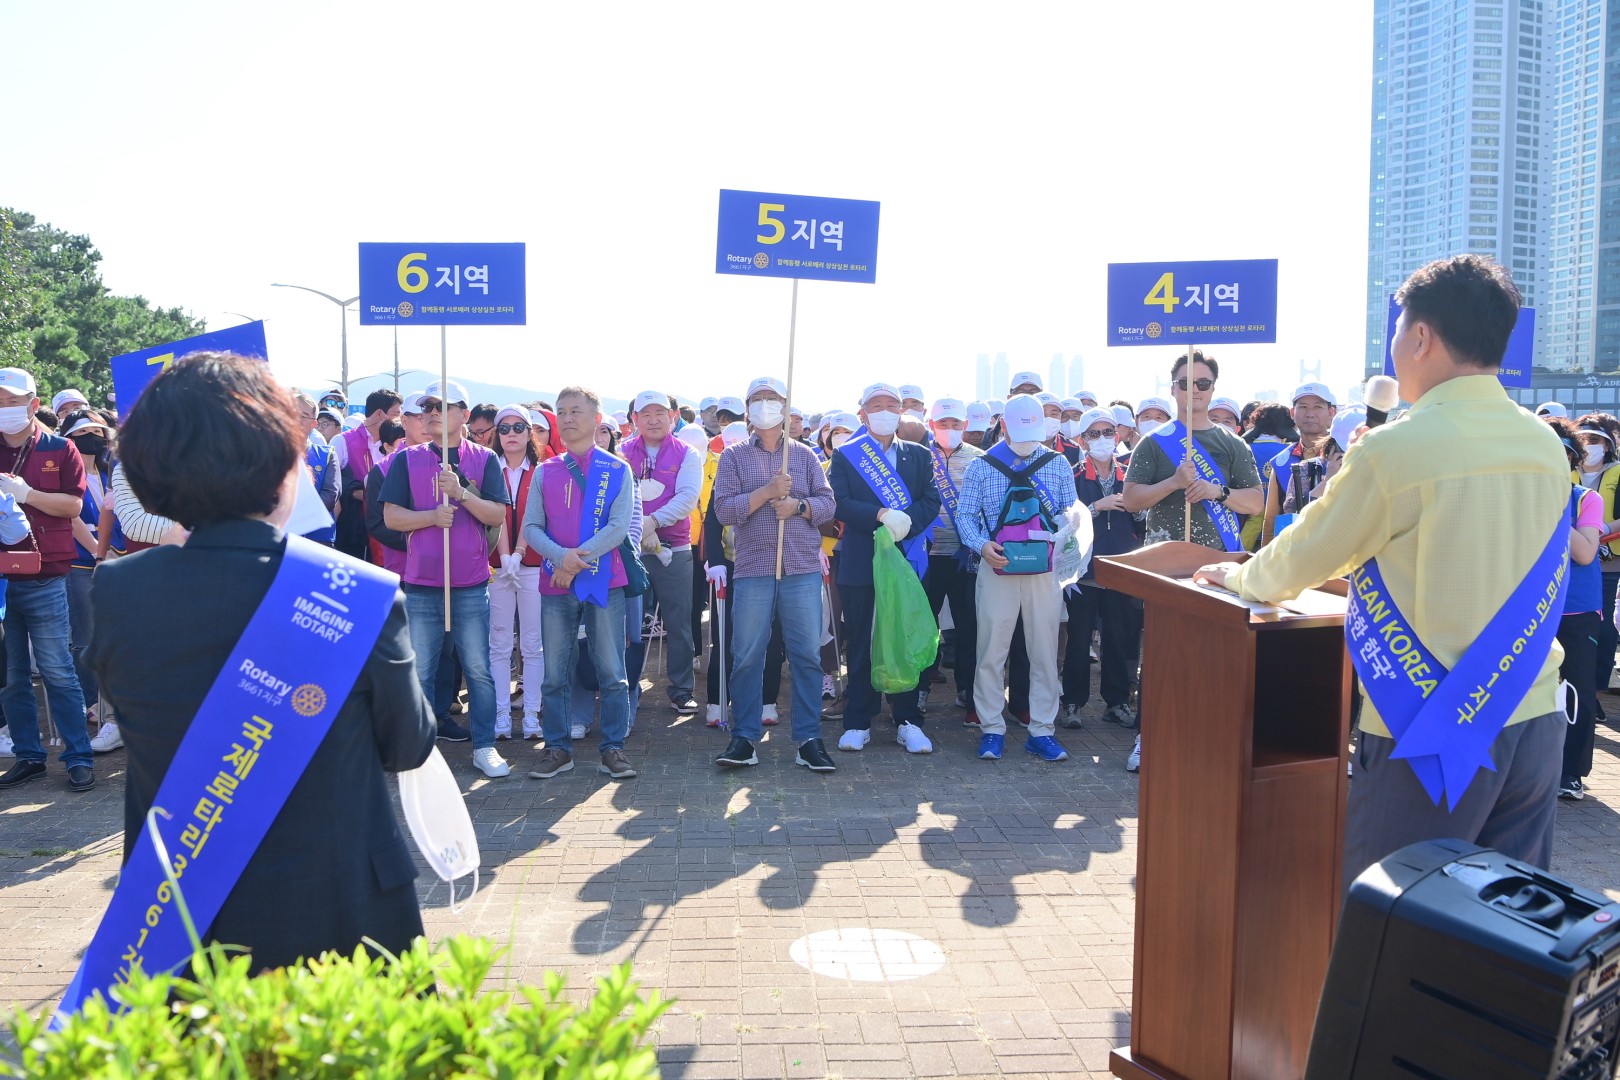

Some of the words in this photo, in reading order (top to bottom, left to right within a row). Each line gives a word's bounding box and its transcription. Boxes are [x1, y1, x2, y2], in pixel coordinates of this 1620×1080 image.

[756, 202, 844, 251] 5지역
[397, 252, 489, 295] 6지역
[727, 254, 753, 264] Rotary
[850, 264, 867, 272] 로타리
[1143, 272, 1239, 314] 4지역
[370, 305, 397, 315] Rotary
[496, 306, 514, 314] 로타리
[1118, 326, 1144, 336] Rotary
[860, 442, 891, 478] IMAGINE
[887, 477, 908, 506] CLEAN
[1224, 508, 1240, 541] KOREA
[291, 611, 344, 643] ROTARY
[293, 596, 354, 634] IMAGINE
[1352, 567, 1391, 624] LEAN
[1379, 619, 1438, 699] KOREA
[237, 678, 284, 707] 3661지구
[239, 658, 293, 697] Rotary
